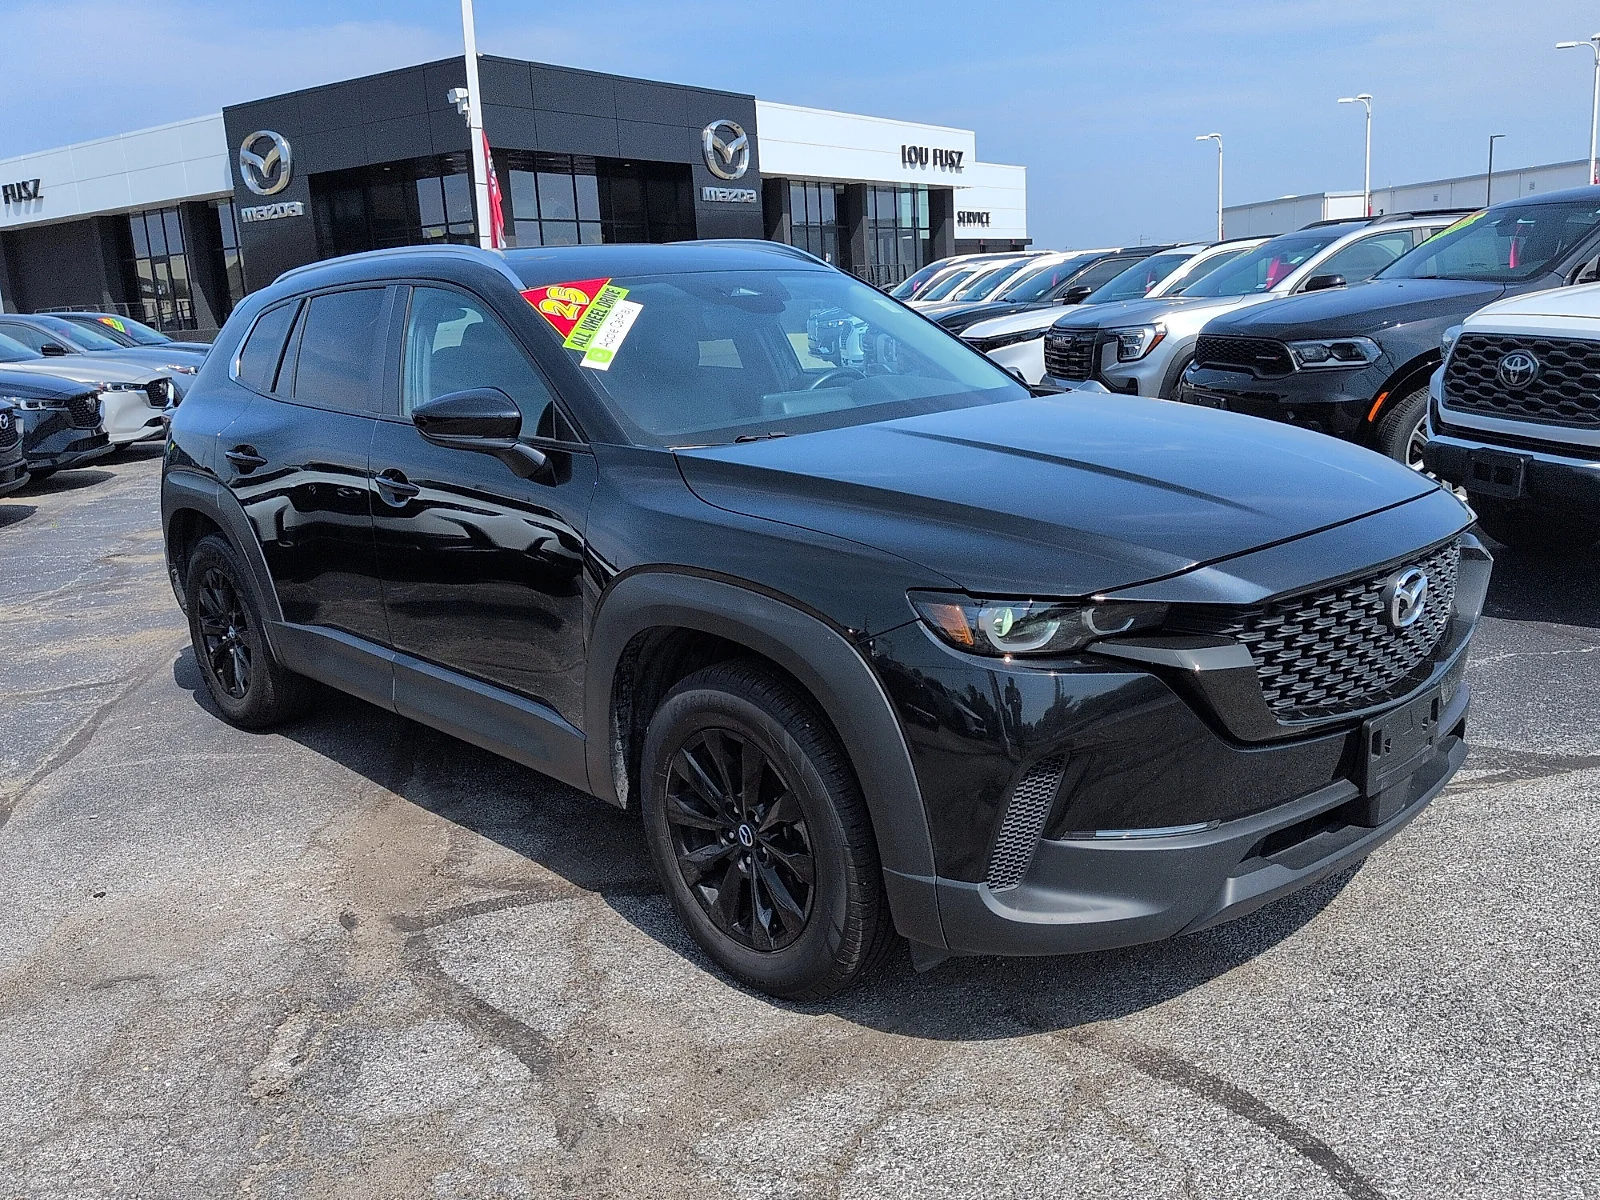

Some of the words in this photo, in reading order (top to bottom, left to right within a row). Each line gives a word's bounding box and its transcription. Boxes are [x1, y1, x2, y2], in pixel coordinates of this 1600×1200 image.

[901, 144, 929, 166] LOU
[933, 148, 965, 169] FUSZ
[2, 178, 44, 205] FUSZ
[702, 186, 757, 203] mazda
[241, 201, 304, 223] mazda
[957, 210, 991, 225] SERVICE
[539, 286, 590, 321] 25
[595, 287, 621, 309] DRIVE
[579, 307, 608, 332] WHEEL
[571, 332, 592, 349] ALL
